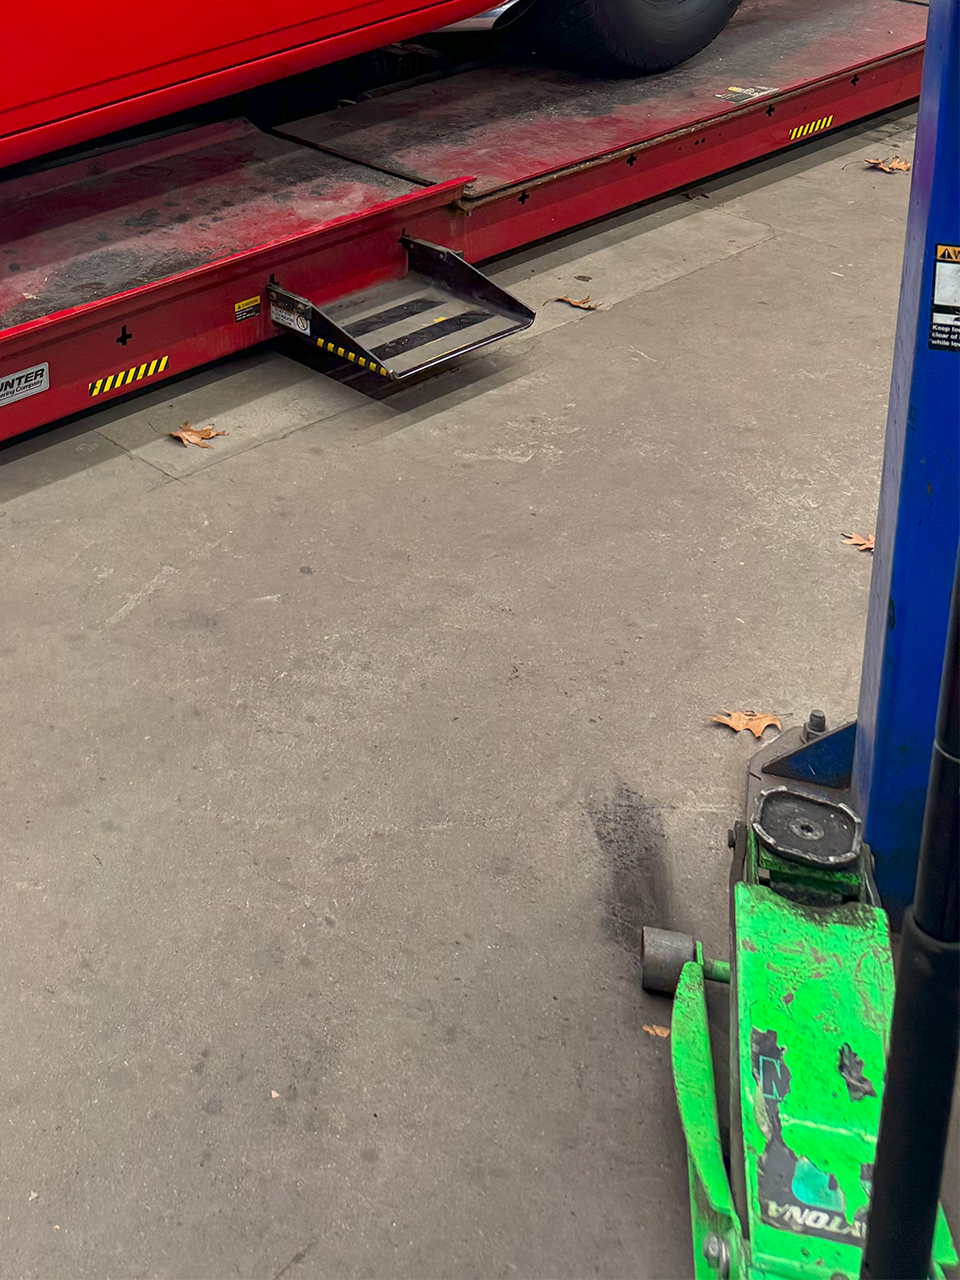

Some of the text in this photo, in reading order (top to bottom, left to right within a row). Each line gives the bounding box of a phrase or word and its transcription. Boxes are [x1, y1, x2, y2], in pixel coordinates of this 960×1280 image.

[932, 324, 951, 332] Keep
[931, 331, 949, 339] clear
[15, 380, 43, 393] Company
